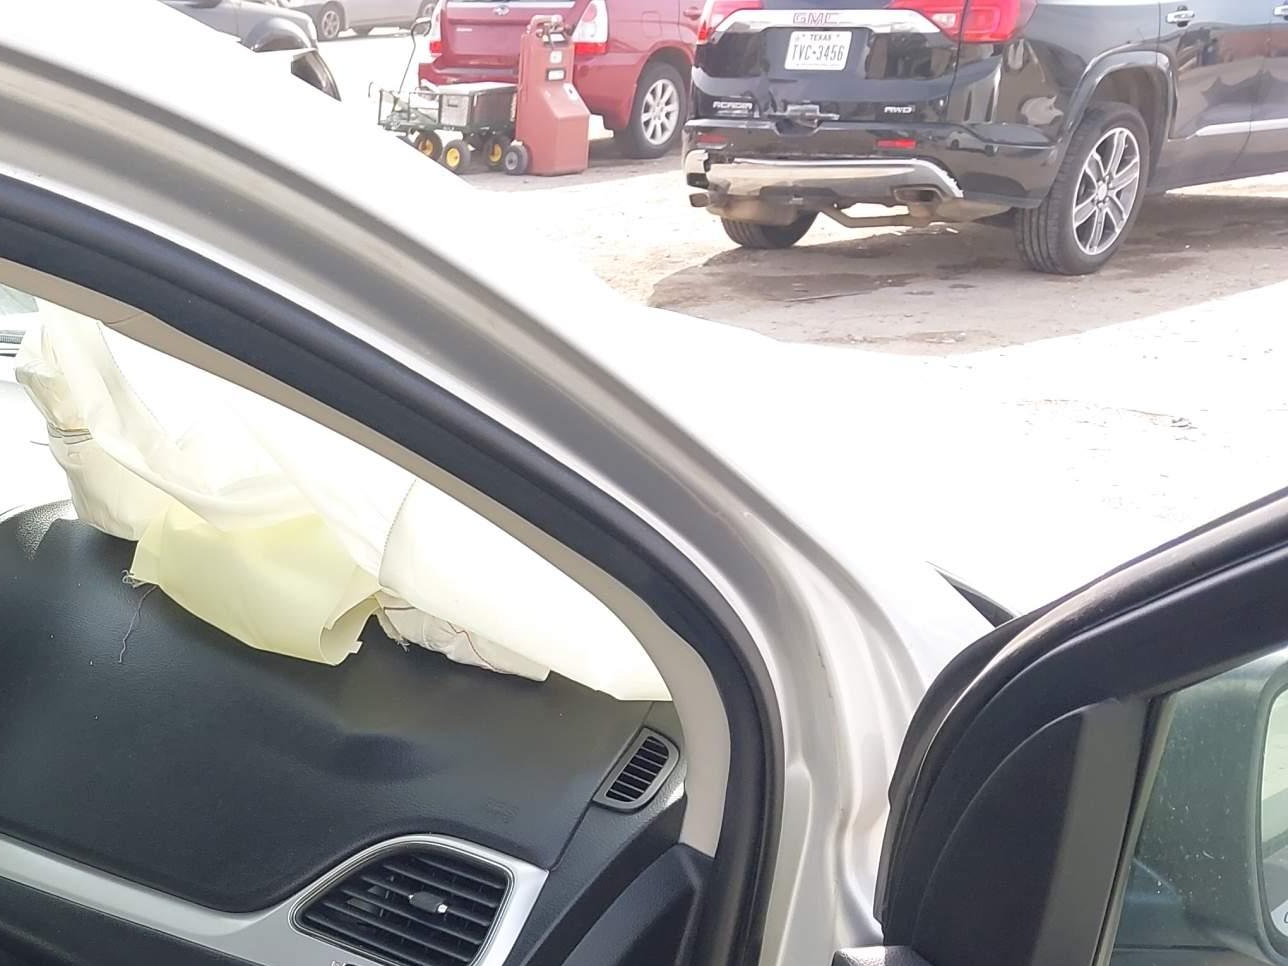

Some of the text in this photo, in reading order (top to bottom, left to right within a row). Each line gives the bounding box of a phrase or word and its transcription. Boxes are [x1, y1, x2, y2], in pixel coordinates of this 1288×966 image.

[792, 12, 840, 25] GMC
[810, 33, 832, 42] TEXAS
[884, 106, 913, 114] AWD
